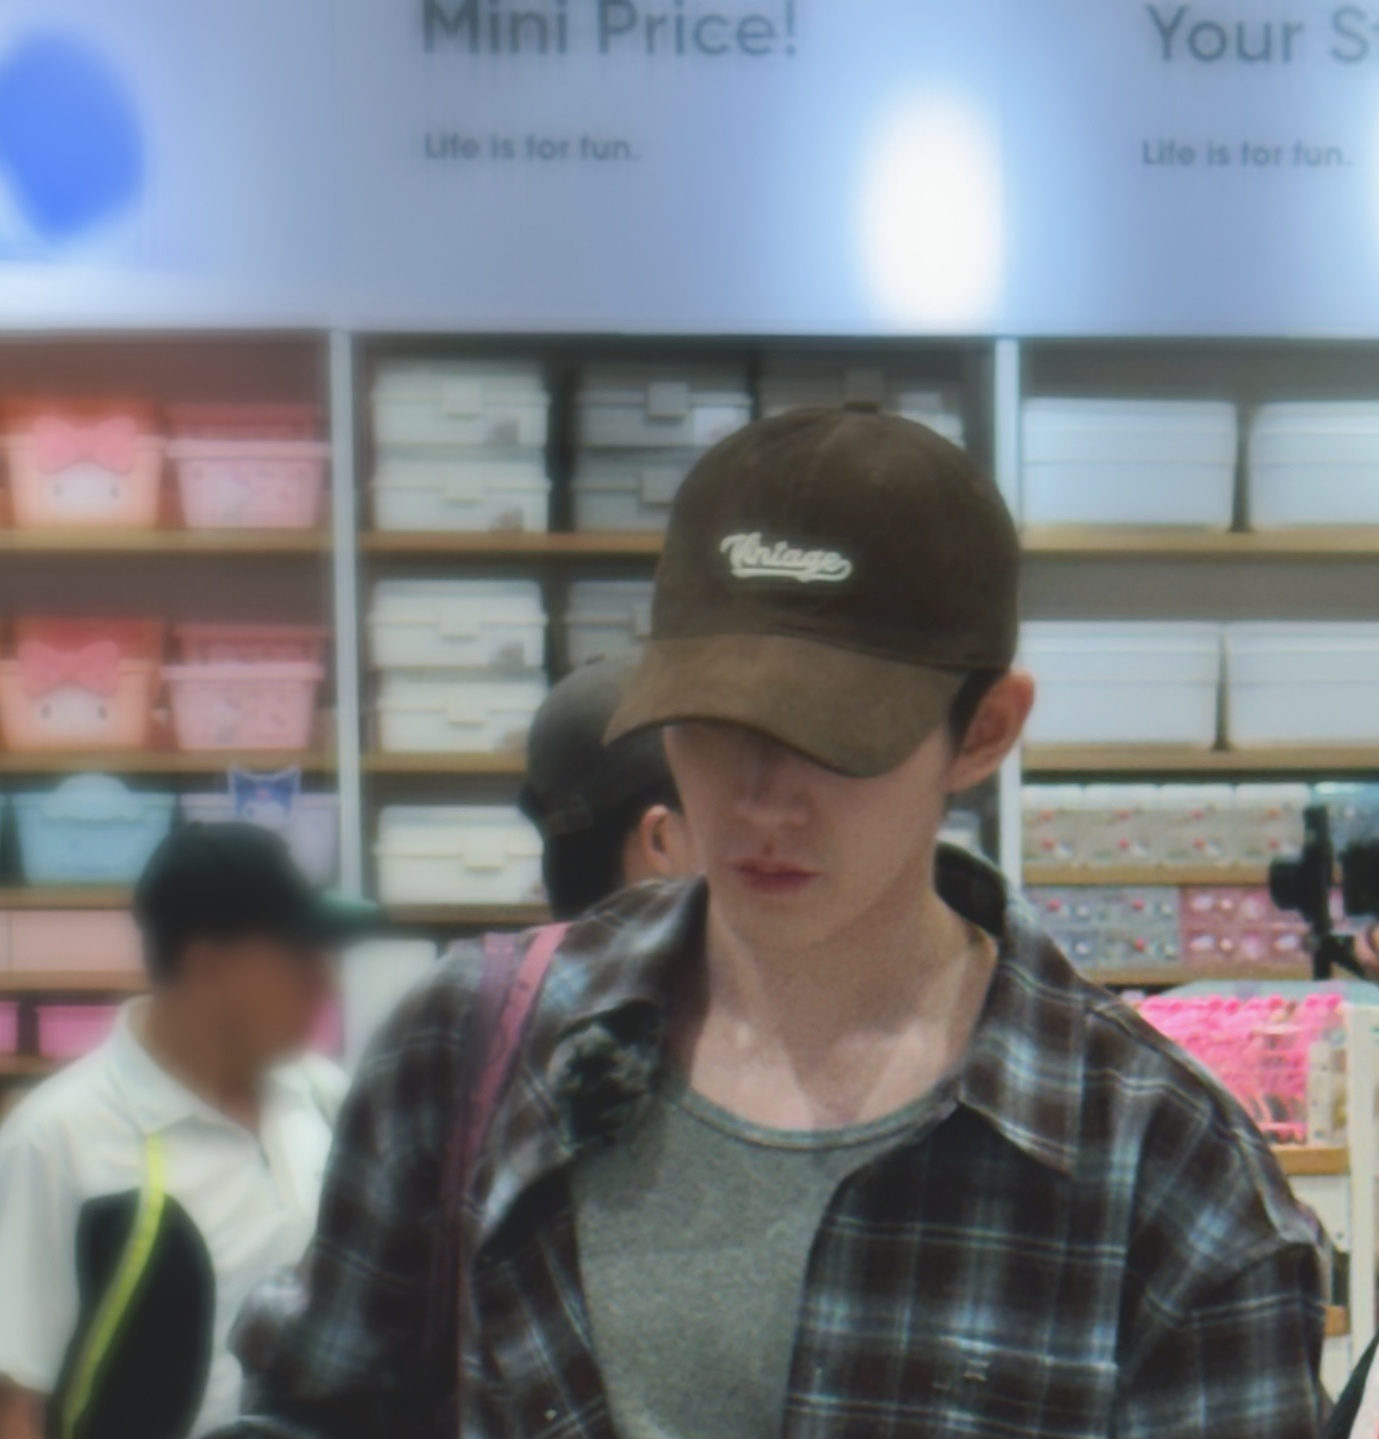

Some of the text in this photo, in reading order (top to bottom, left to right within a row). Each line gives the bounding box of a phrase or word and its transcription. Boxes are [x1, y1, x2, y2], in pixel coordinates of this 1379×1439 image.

[423, 0, 798, 56] Mini Price!
[1145, 4, 1304, 63] Your
[424, 134, 640, 160] Life is for fun.
[1142, 140, 1353, 167] Life is for fun.
